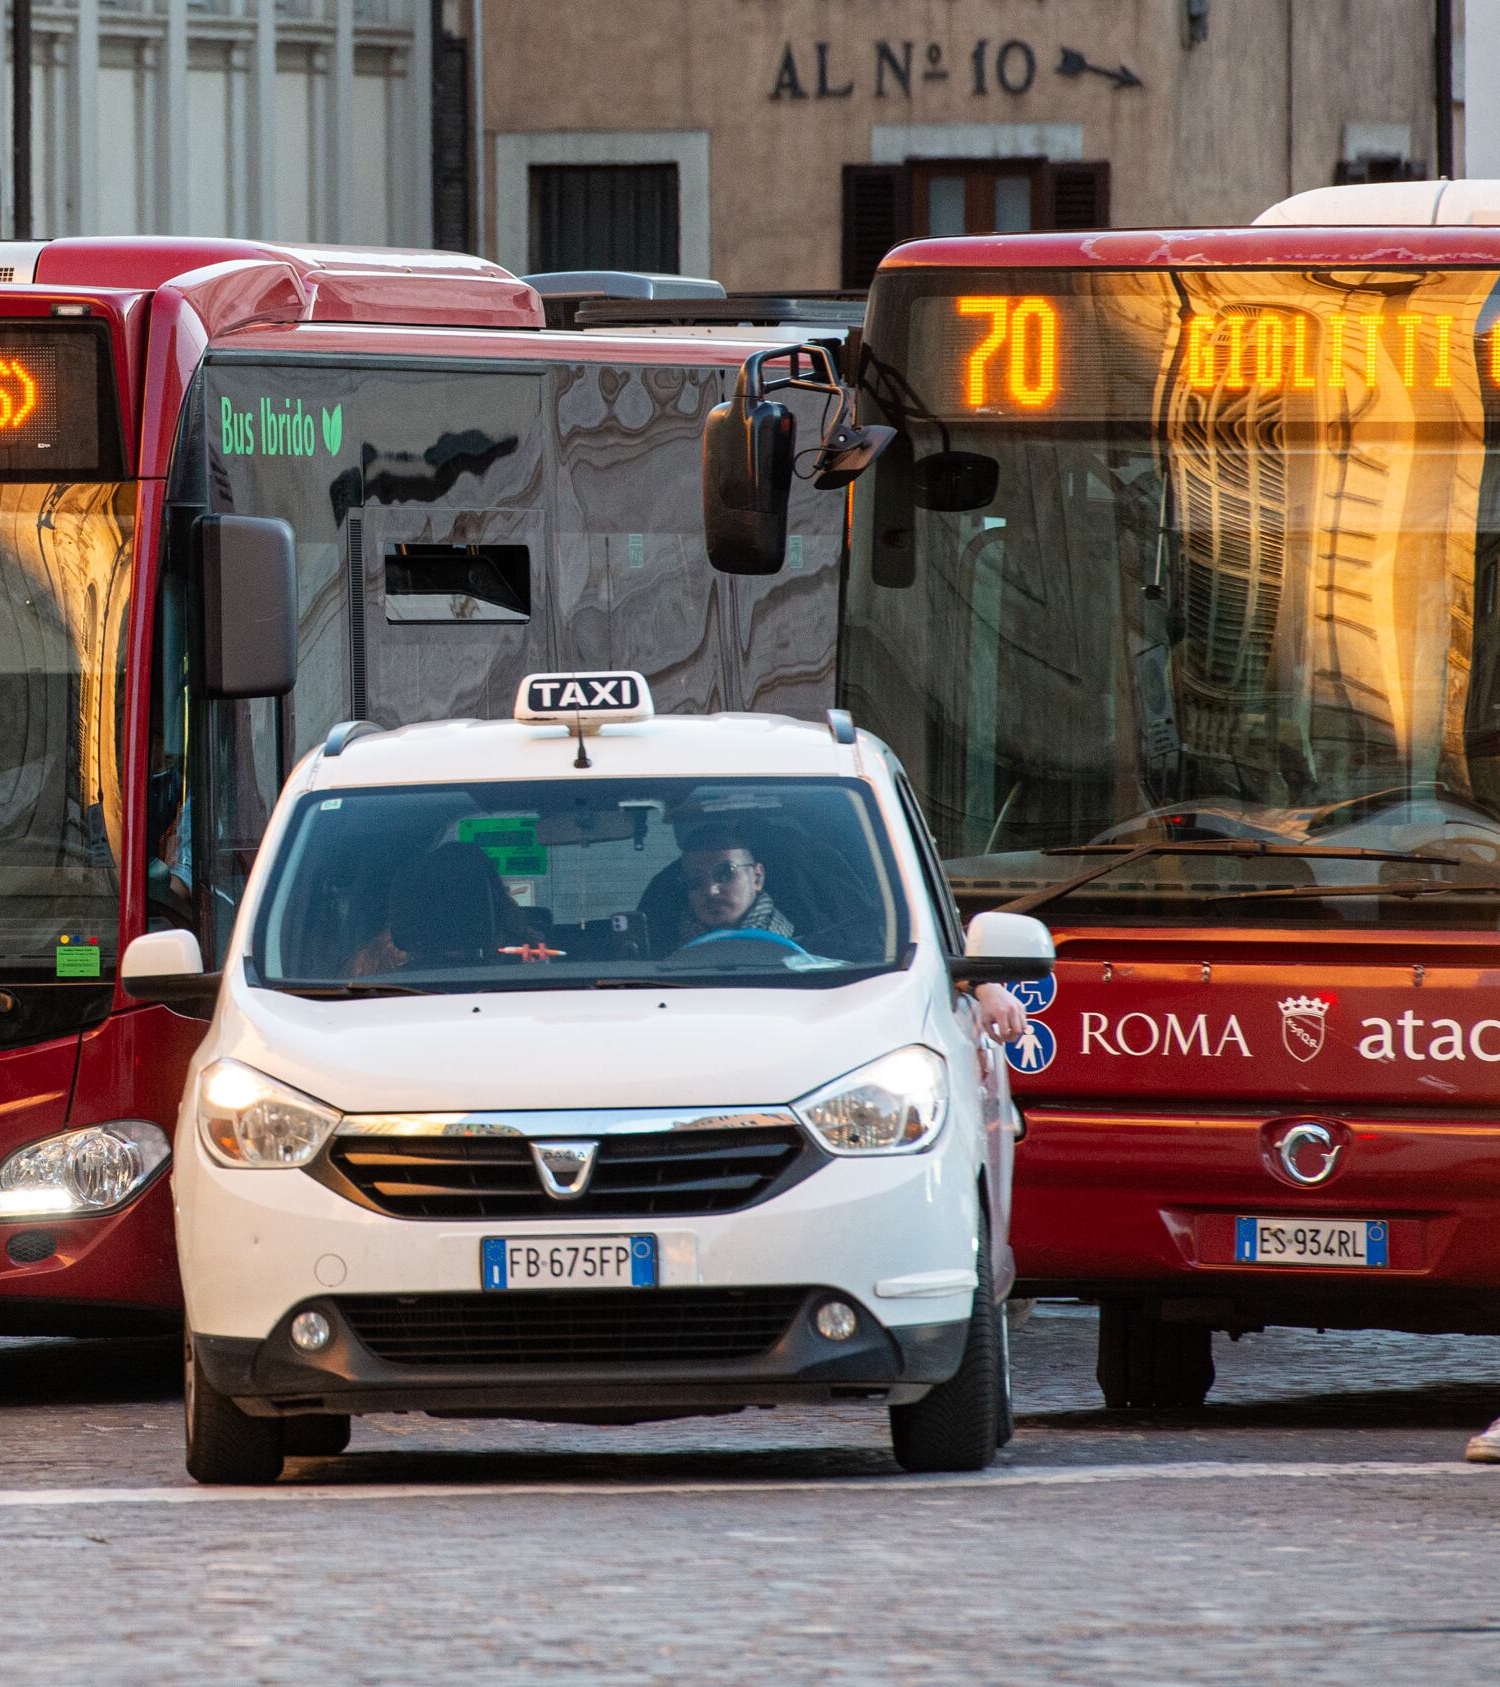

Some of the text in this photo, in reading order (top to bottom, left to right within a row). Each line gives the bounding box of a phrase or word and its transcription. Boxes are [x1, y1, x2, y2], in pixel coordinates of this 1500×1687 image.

[770, 40, 855, 101] AL
[970, 37, 1037, 96] 10
[960, 299, 1054, 404] 70
[1188, 314, 1453, 387] GIOLITTI
[221, 396, 315, 456] Bus Ibrido
[532, 680, 631, 707] TAXI
[1080, 1012, 1253, 1056] ROMA
[1359, 1009, 1500, 1062] atac
